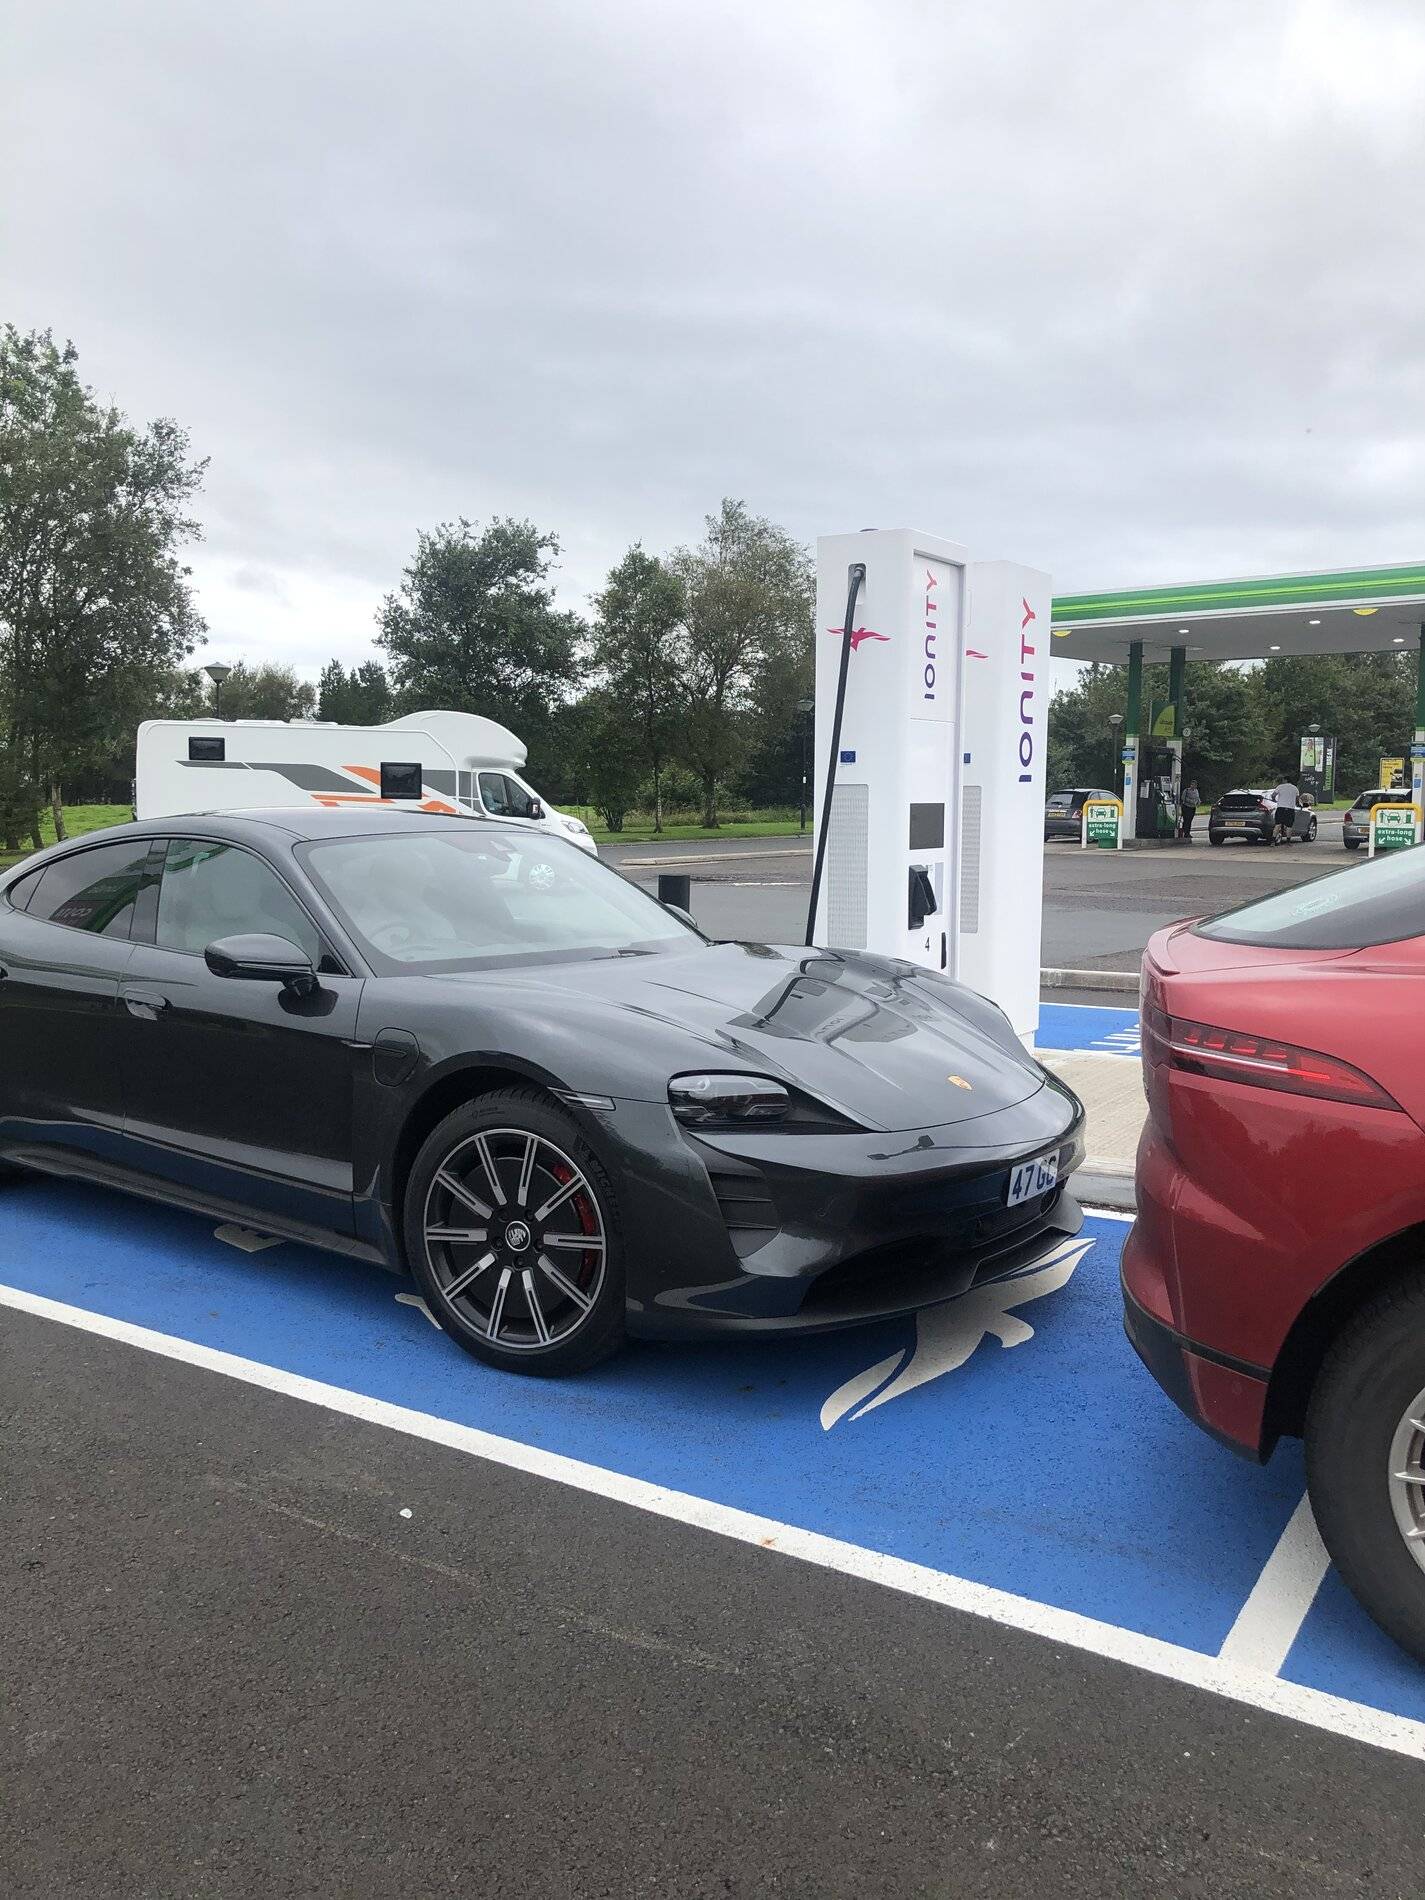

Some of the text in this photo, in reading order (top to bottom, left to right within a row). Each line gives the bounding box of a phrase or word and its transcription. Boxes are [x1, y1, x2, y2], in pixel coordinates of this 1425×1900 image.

[924, 569, 937, 700] IONITY
[1018, 597, 1036, 782] IONITY
[1377, 829, 1413, 837] extra-long
[924, 936, 930, 952] 4
[1011, 1164, 1036, 1200] 47
